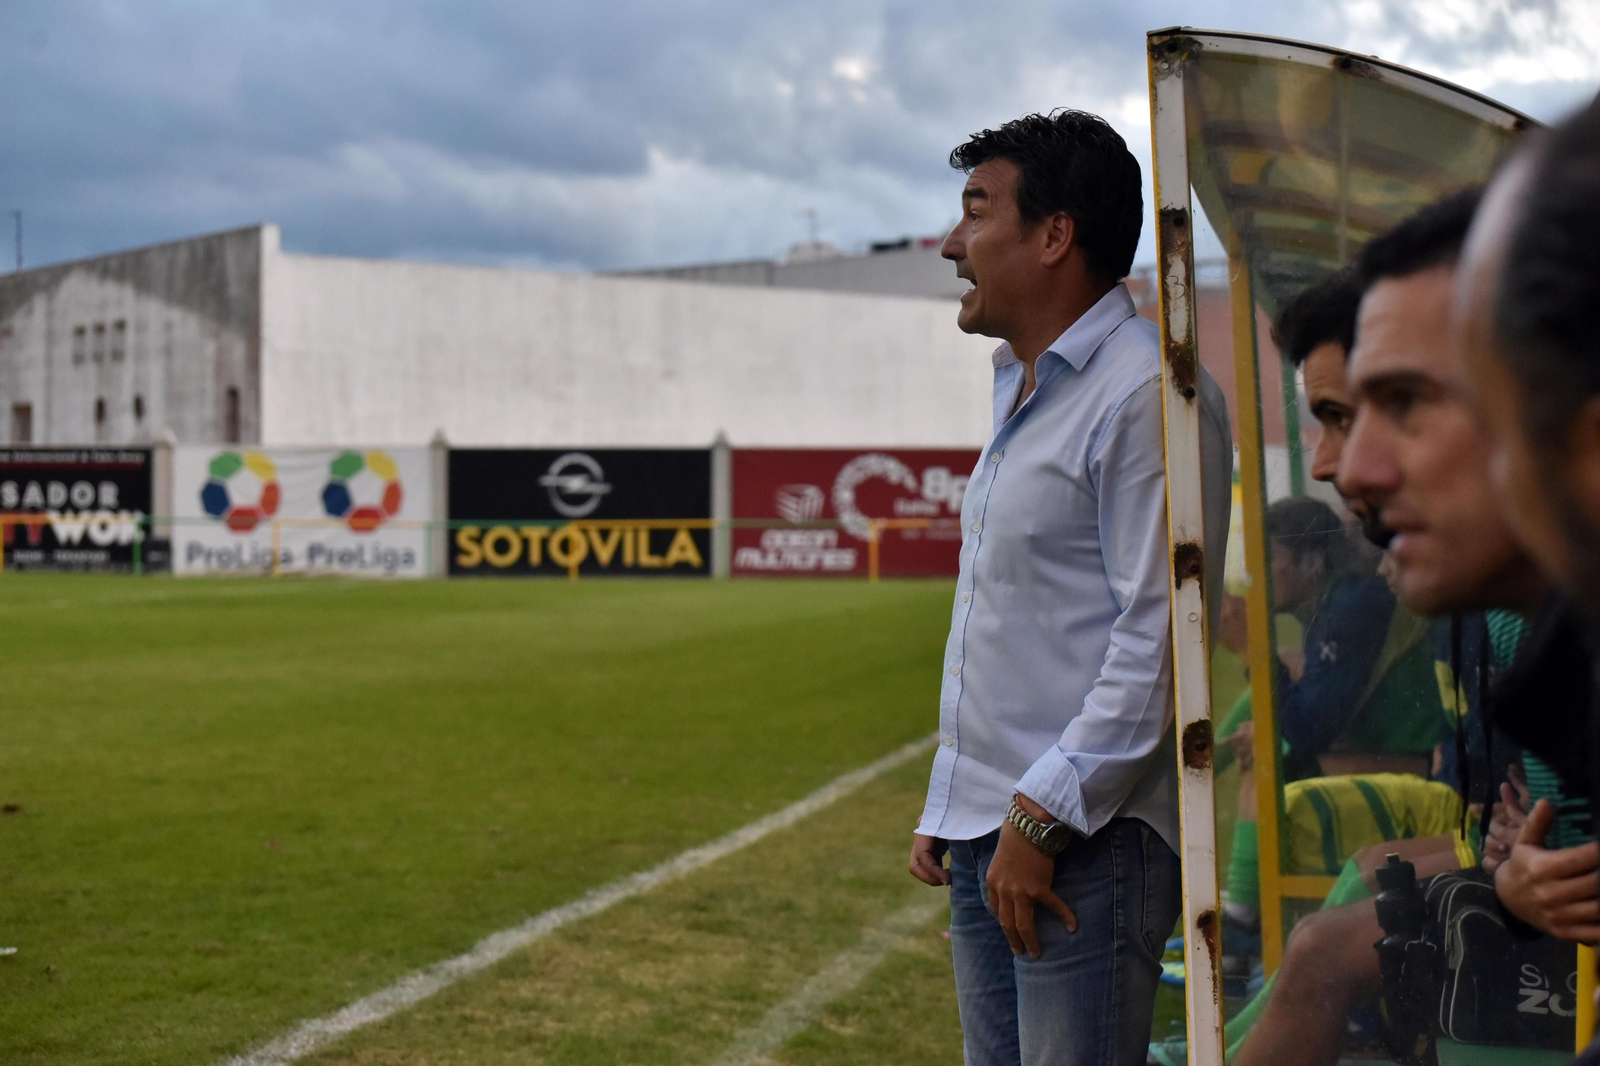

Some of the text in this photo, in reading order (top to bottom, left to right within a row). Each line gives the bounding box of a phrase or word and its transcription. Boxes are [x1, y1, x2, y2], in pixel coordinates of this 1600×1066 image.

[1, 480, 119, 508] SADOR
[307, 541, 415, 570] ProLiga
[456, 525, 703, 568] SOTOVILA
